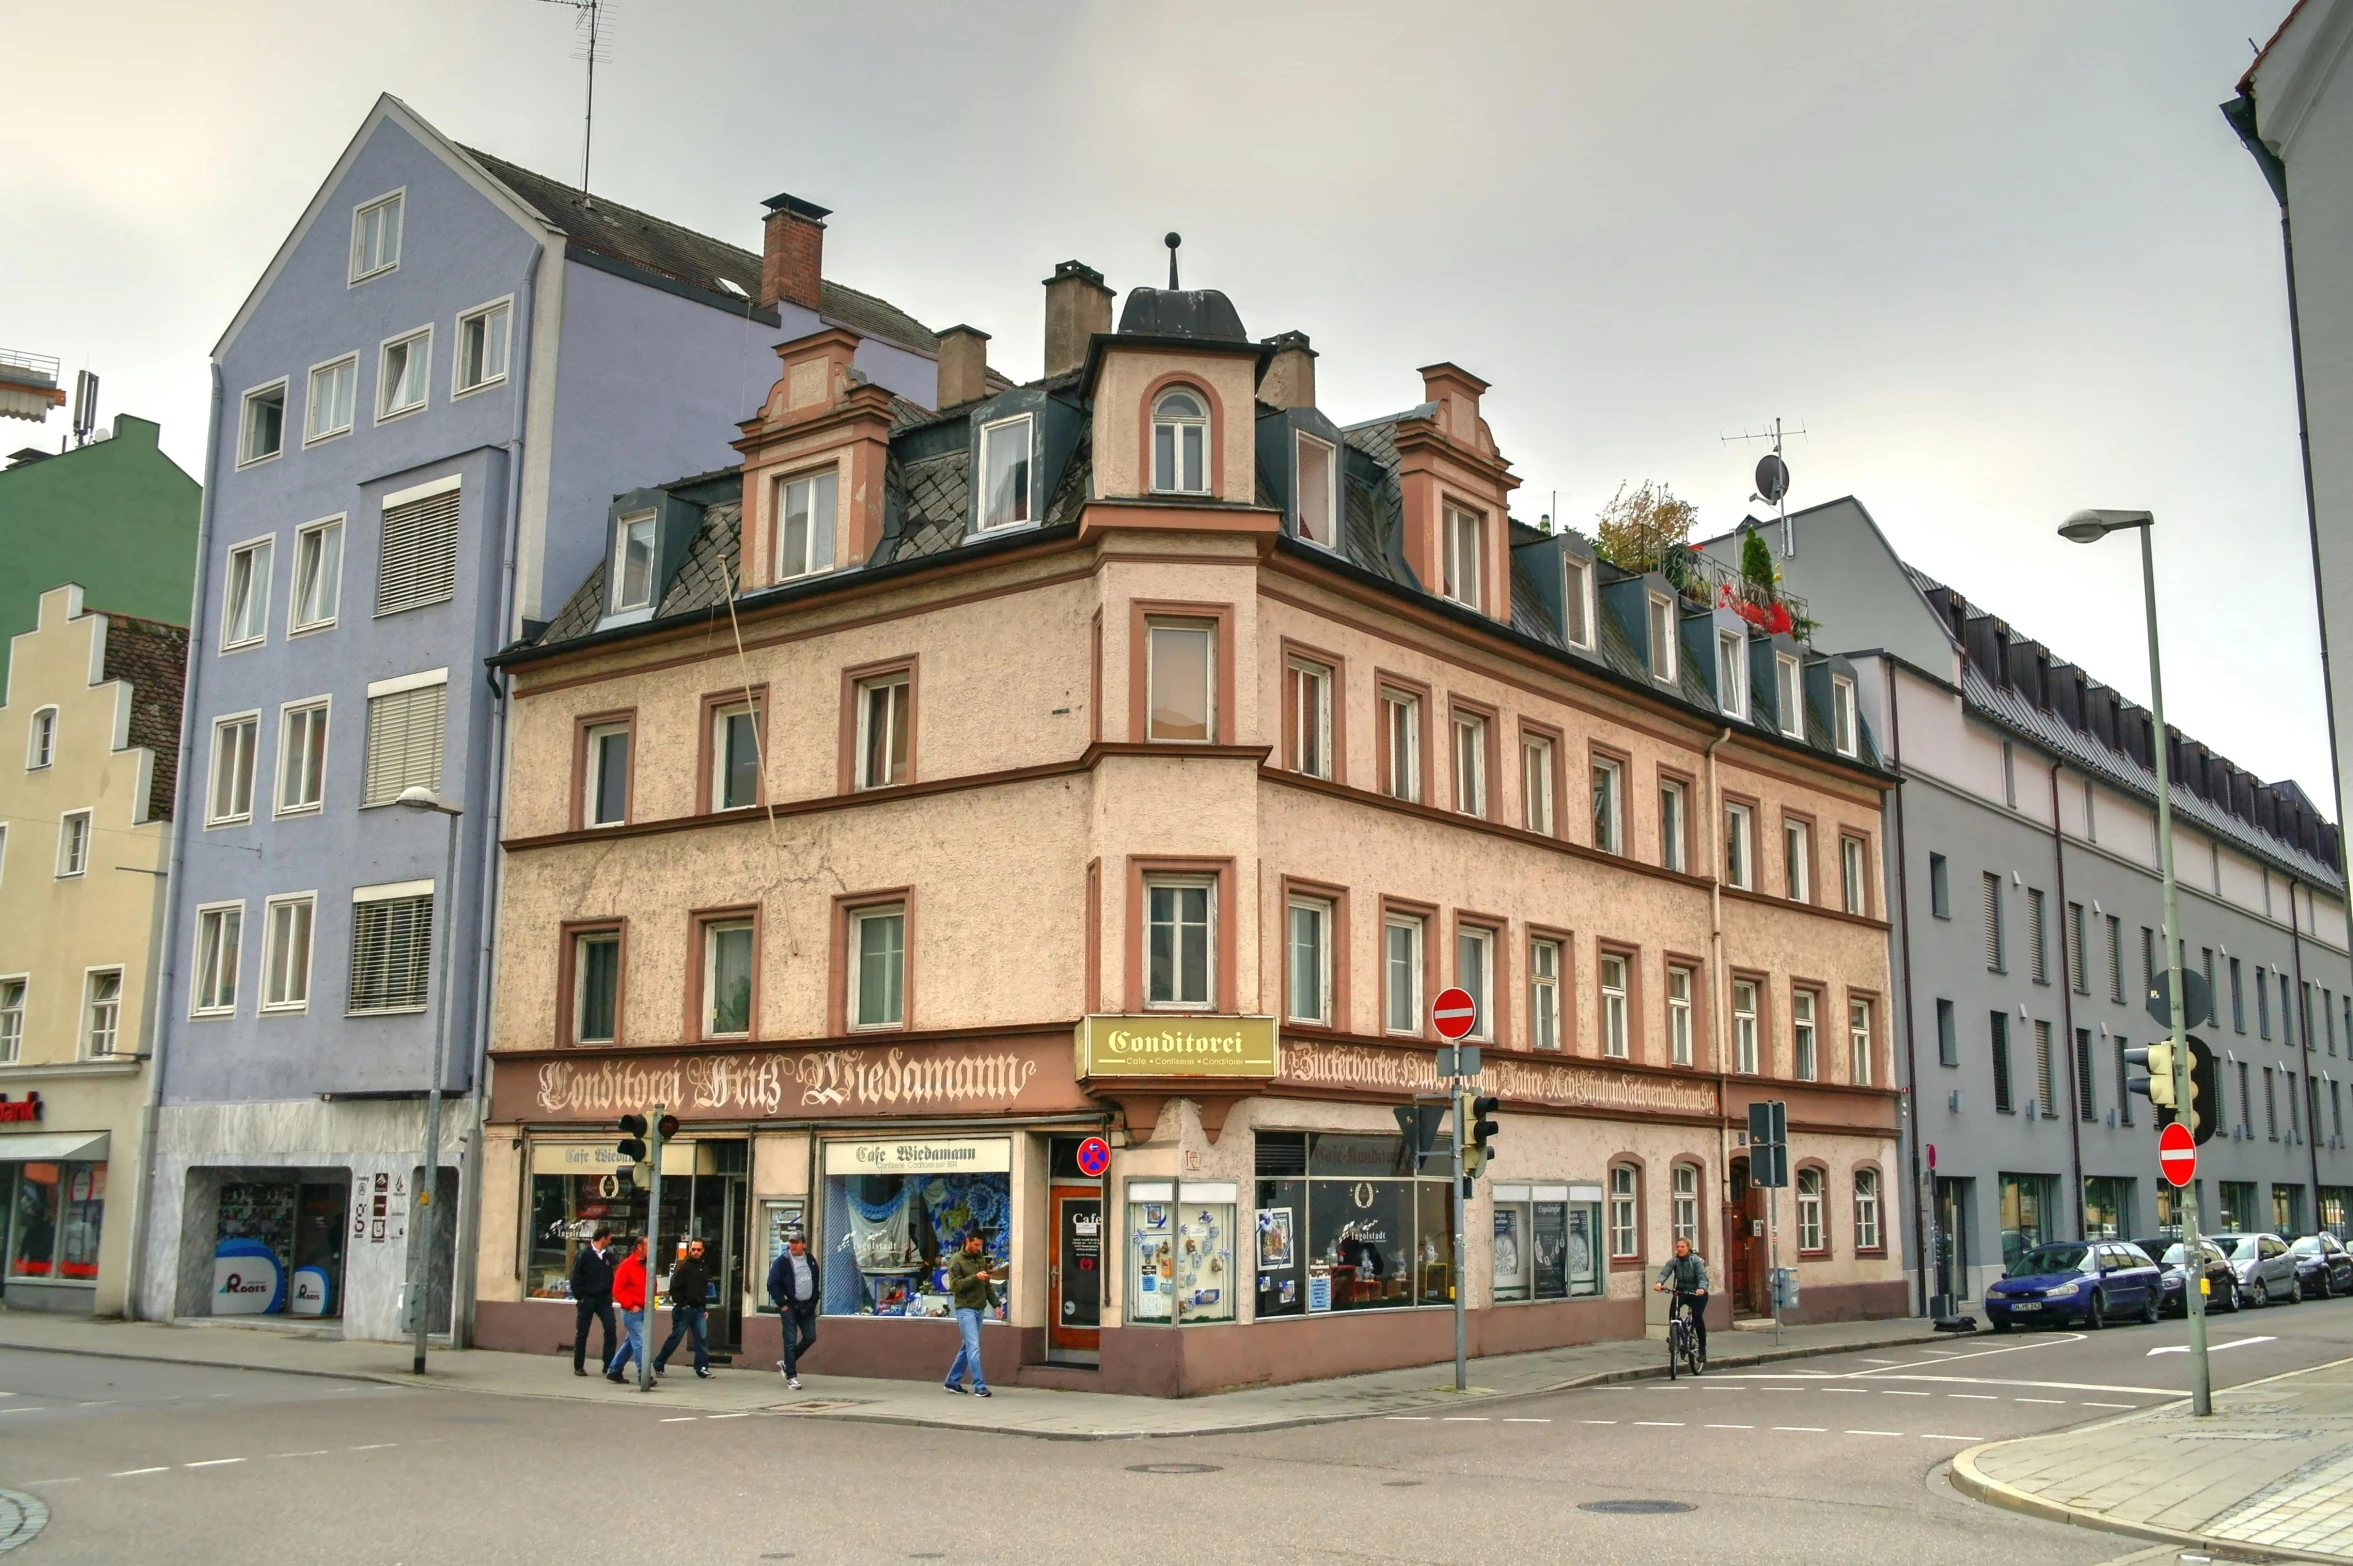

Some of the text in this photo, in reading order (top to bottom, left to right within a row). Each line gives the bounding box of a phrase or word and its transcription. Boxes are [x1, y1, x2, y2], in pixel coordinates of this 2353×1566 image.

[1108, 1030, 1243, 1054] Conditorei
[1126, 1057, 1244, 1066] Cafe Confiserie Conditorei
[537, 1059, 685, 1113] Conditorei
[687, 1053, 795, 1114] Fritz
[796, 1047, 1037, 1107] Wiedamann
[1497, 1060, 1543, 1100] Jahre
[565, 1147, 589, 1165] Cafe
[855, 1145, 976, 1165] Cafe Wiedamann
[1072, 1212, 1102, 1226] Cafe
[1351, 1231, 1386, 1243] Ingolstadt
